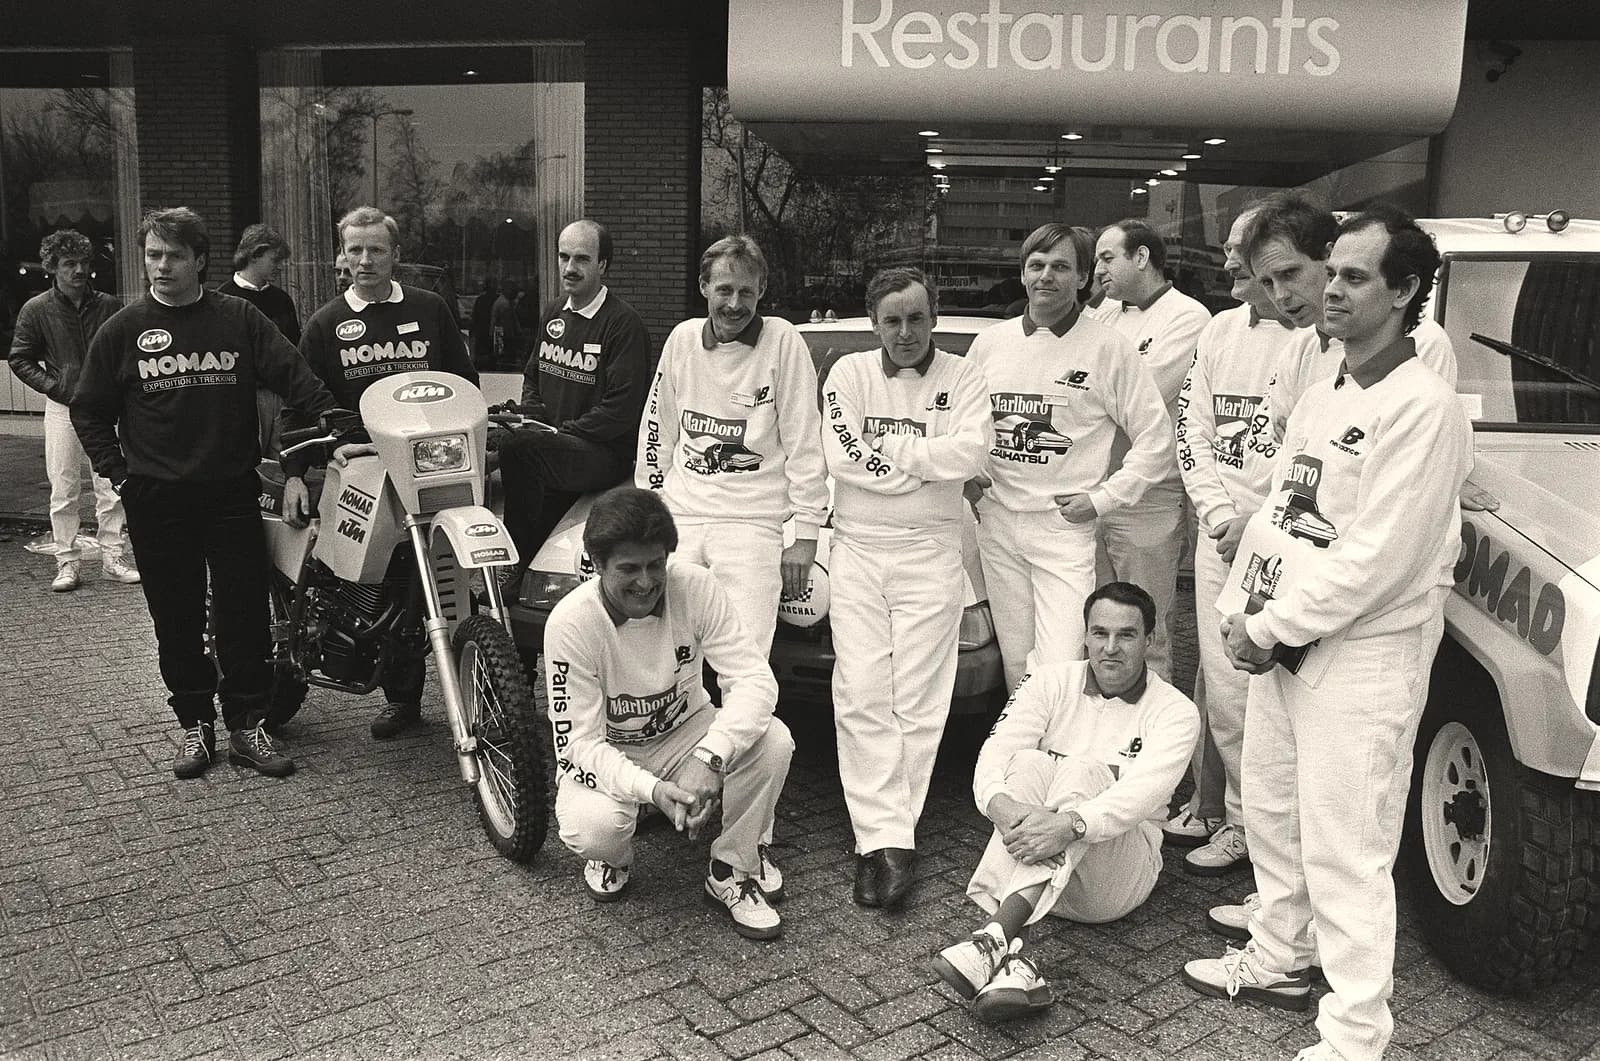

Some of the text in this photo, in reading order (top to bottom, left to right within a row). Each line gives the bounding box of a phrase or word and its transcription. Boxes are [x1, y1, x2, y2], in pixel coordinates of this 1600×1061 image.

[840, 0, 1341, 76] Restaurants
[138, 351, 236, 379] NOMAD
[340, 340, 428, 367] NOMAD
[539, 341, 598, 372] NOMAD
[143, 377, 192, 392] EXPEDITION
[200, 375, 238, 384] TREKKING
[344, 365, 386, 378] EXPEDITION
[394, 362, 429, 371] TREKKING
[400, 385, 446, 401] KTM
[1214, 396, 1259, 418] Marlb
[646, 419, 661, 470] Dakar
[865, 453, 891, 478] '86
[339, 489, 374, 516] NOMAD
[337, 518, 366, 545] KTM
[473, 549, 506, 559] NOMAD
[1453, 521, 1566, 657] OMAD
[779, 604, 817, 617] ARCHAL
[553, 660, 571, 713] Paris
[608, 692, 675, 716] Marlboro
[555, 720, 576, 774] Daar
